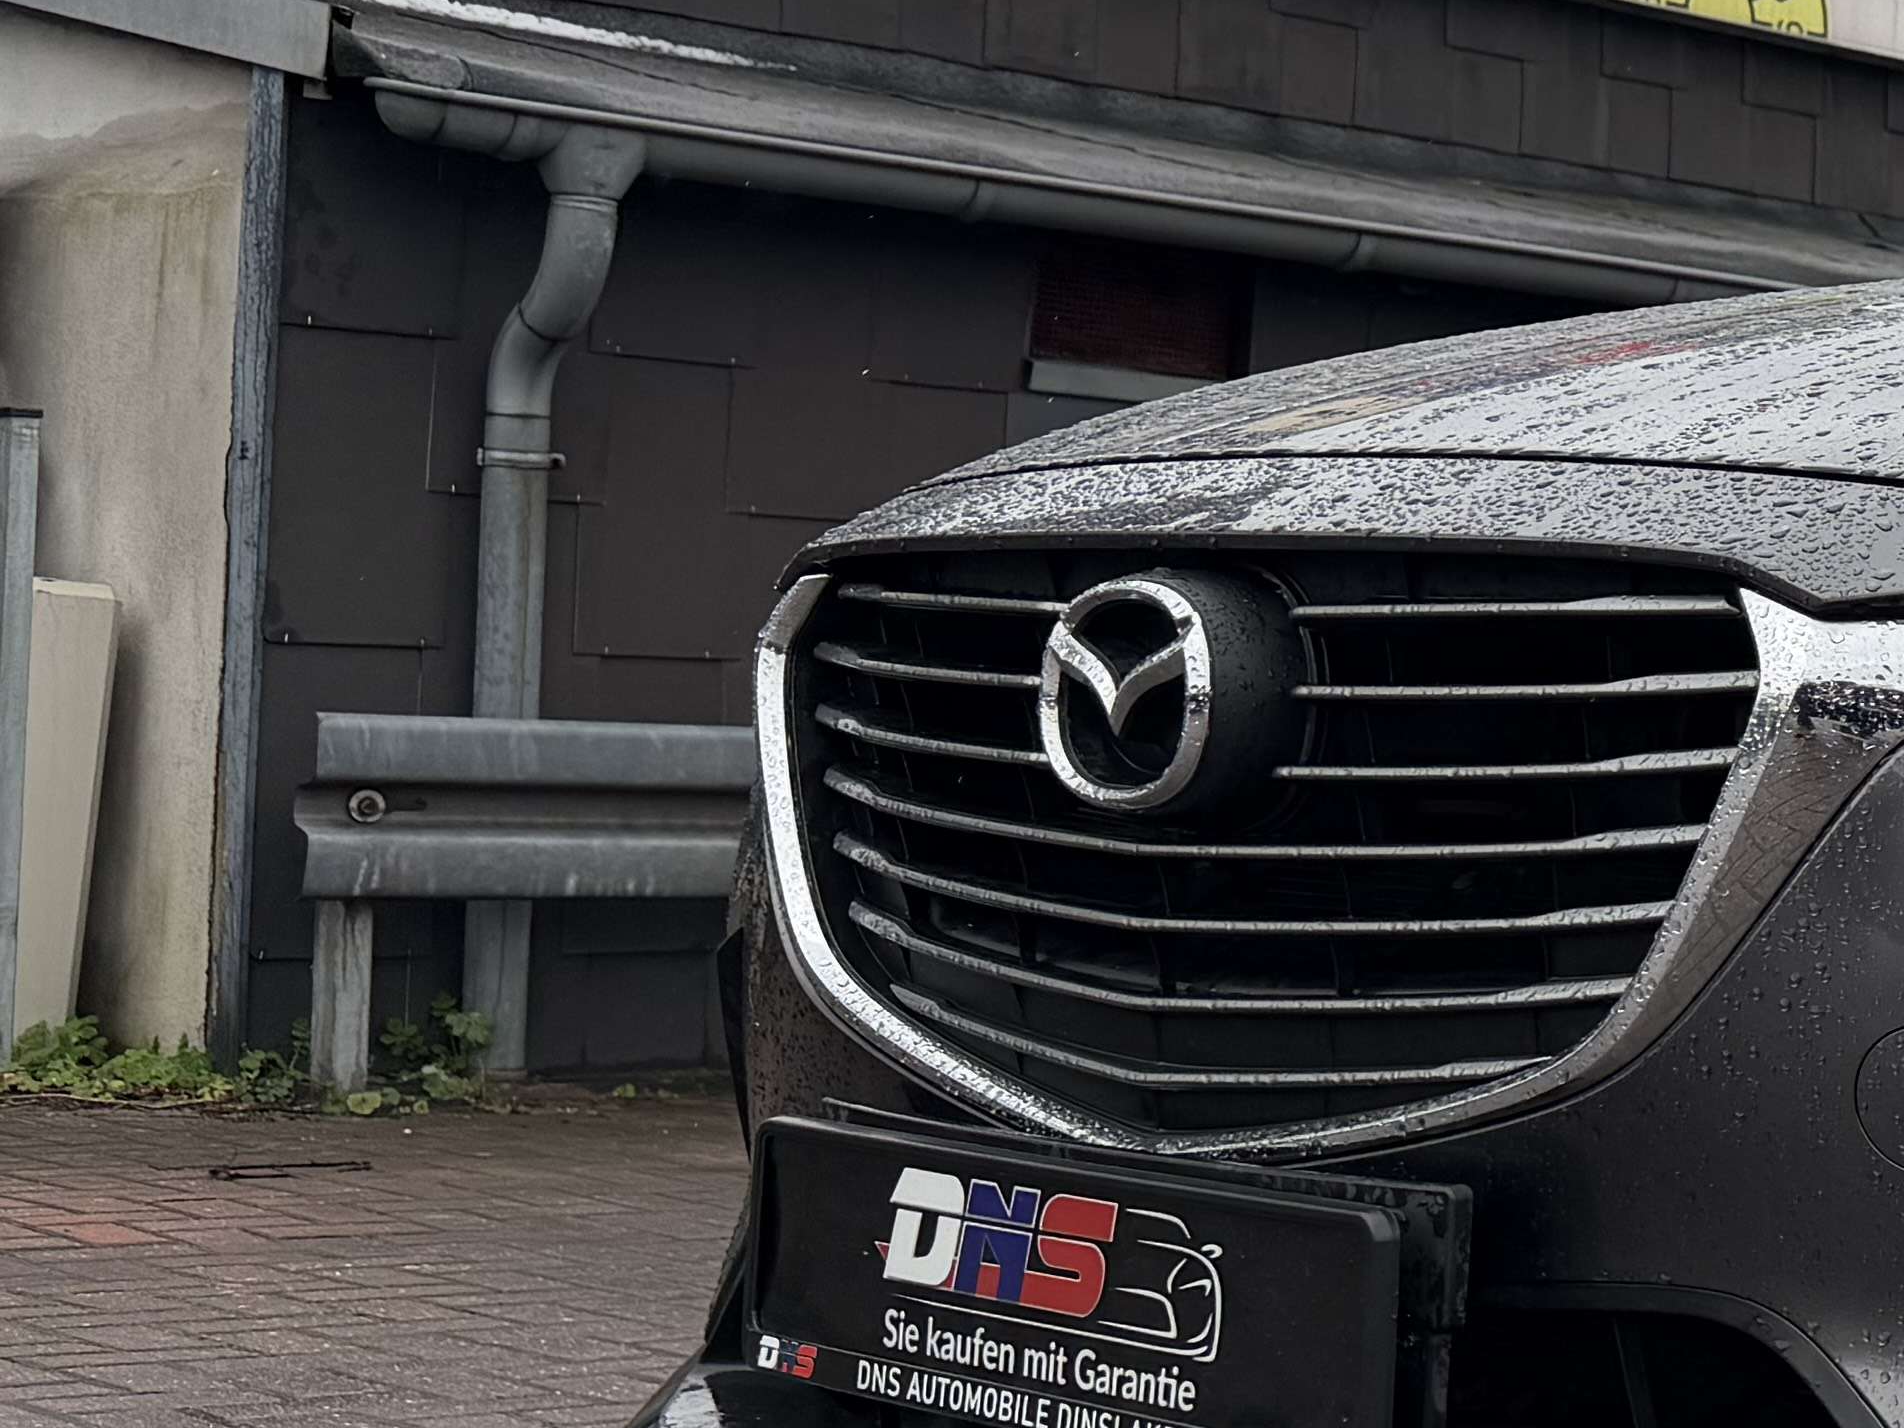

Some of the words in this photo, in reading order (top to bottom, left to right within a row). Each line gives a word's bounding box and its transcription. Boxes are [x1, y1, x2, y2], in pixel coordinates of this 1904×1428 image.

[883, 1167, 1119, 1318] DNS
[856, 1358, 902, 1398] DNS
[882, 1307, 921, 1354] Sie
[926, 1316, 1016, 1374] kaufen
[1023, 1340, 1068, 1386] mit
[1074, 1348, 1197, 1412] Garantie
